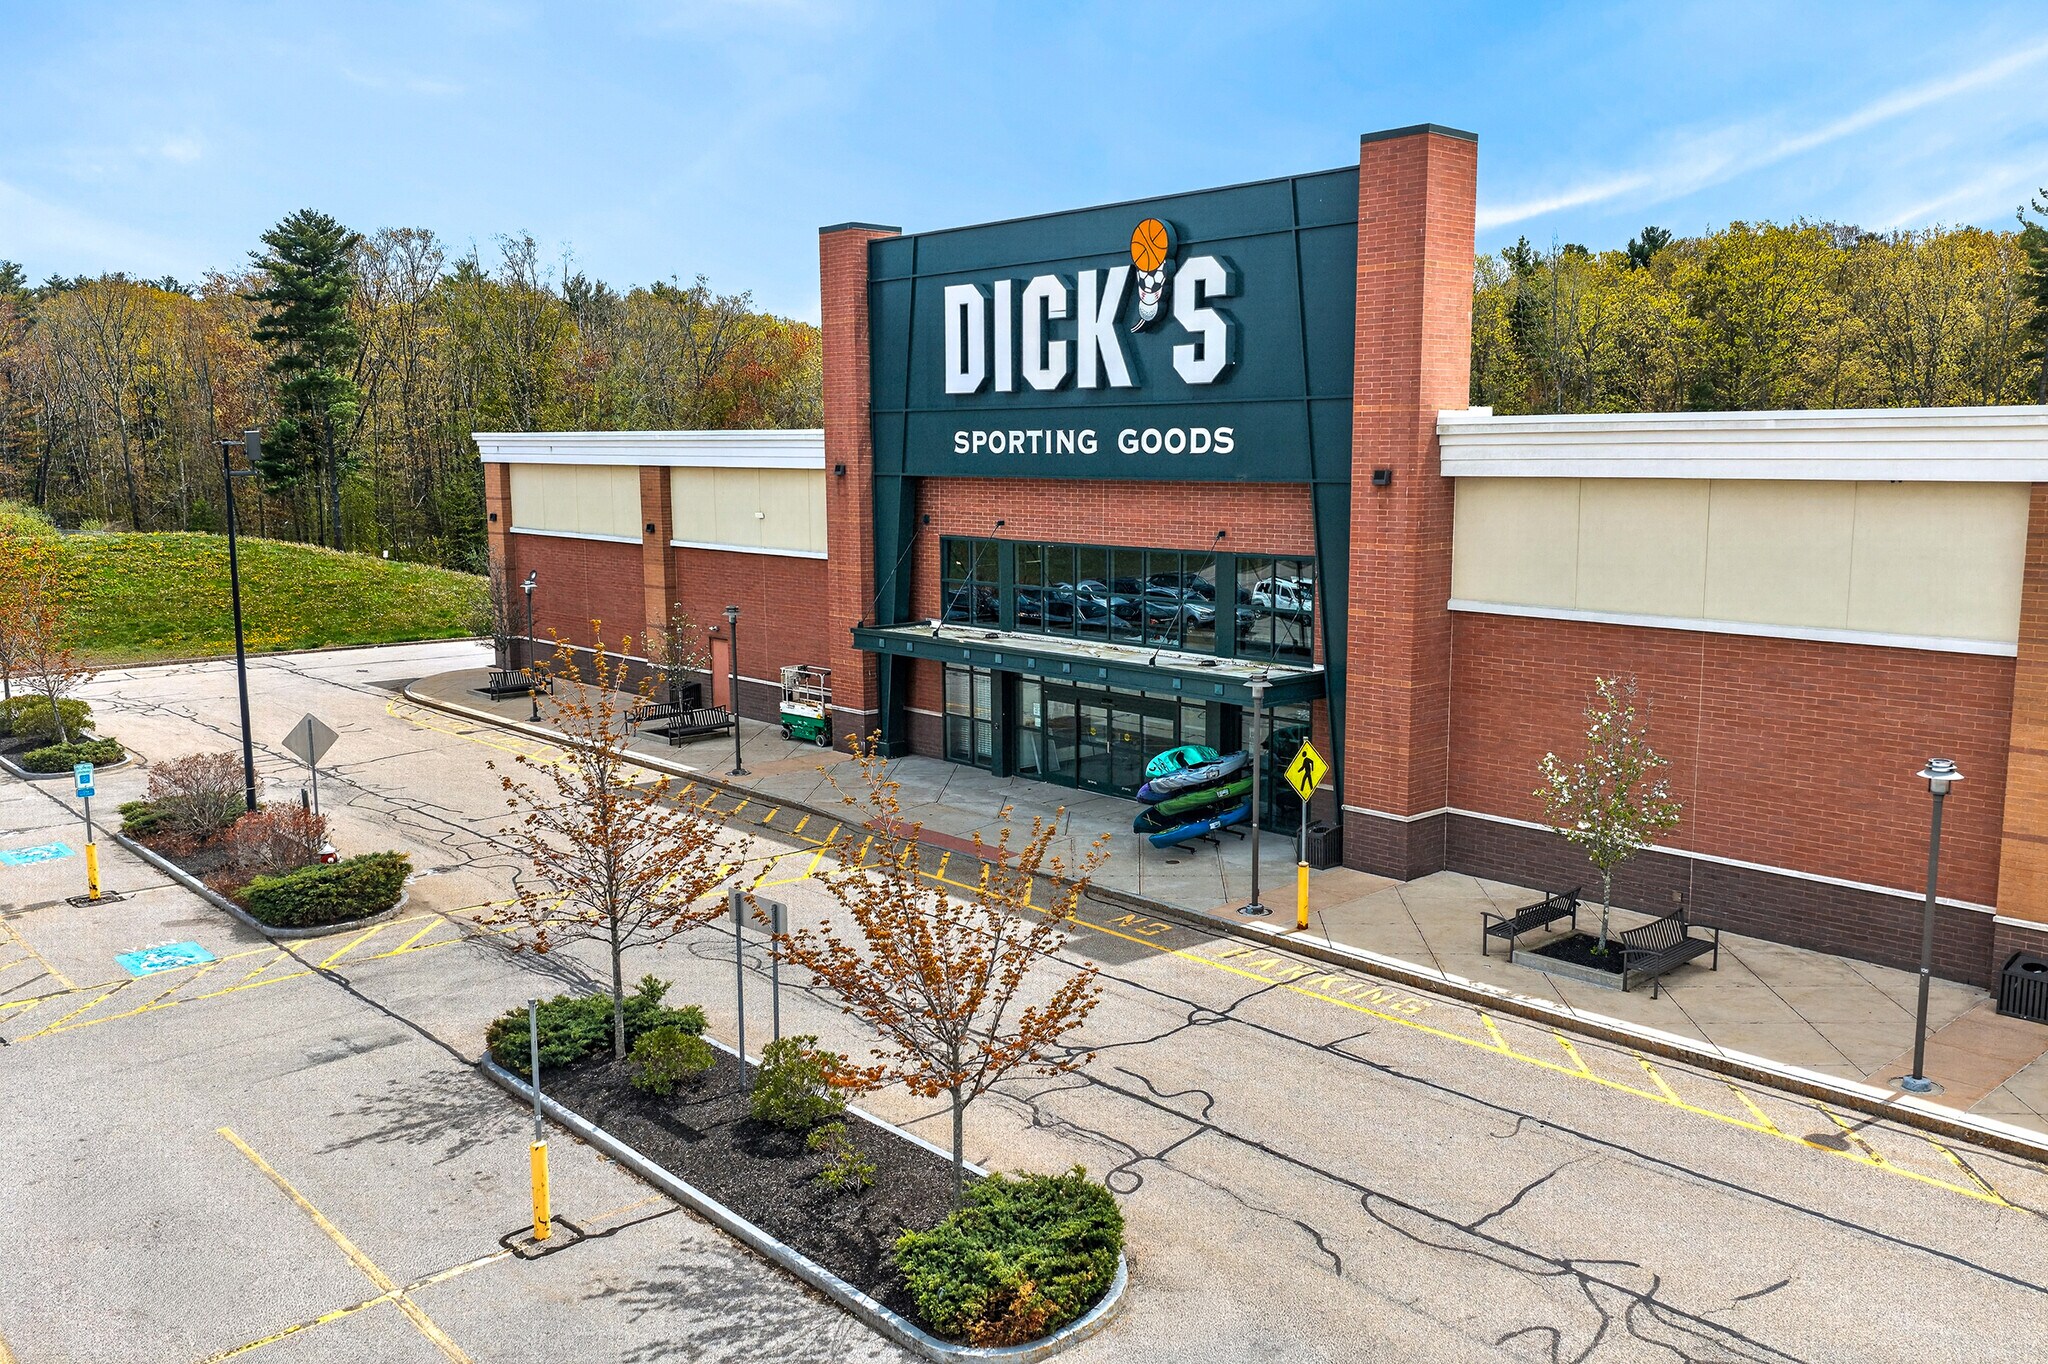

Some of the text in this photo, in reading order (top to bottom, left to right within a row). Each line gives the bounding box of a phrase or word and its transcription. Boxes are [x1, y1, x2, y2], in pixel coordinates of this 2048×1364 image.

[944, 218, 1236, 395] DICK'S
[953, 426, 1236, 455] SPORTING GOODS
[1106, 913, 1173, 936] NO
[1217, 947, 1434, 1015] PARKING
